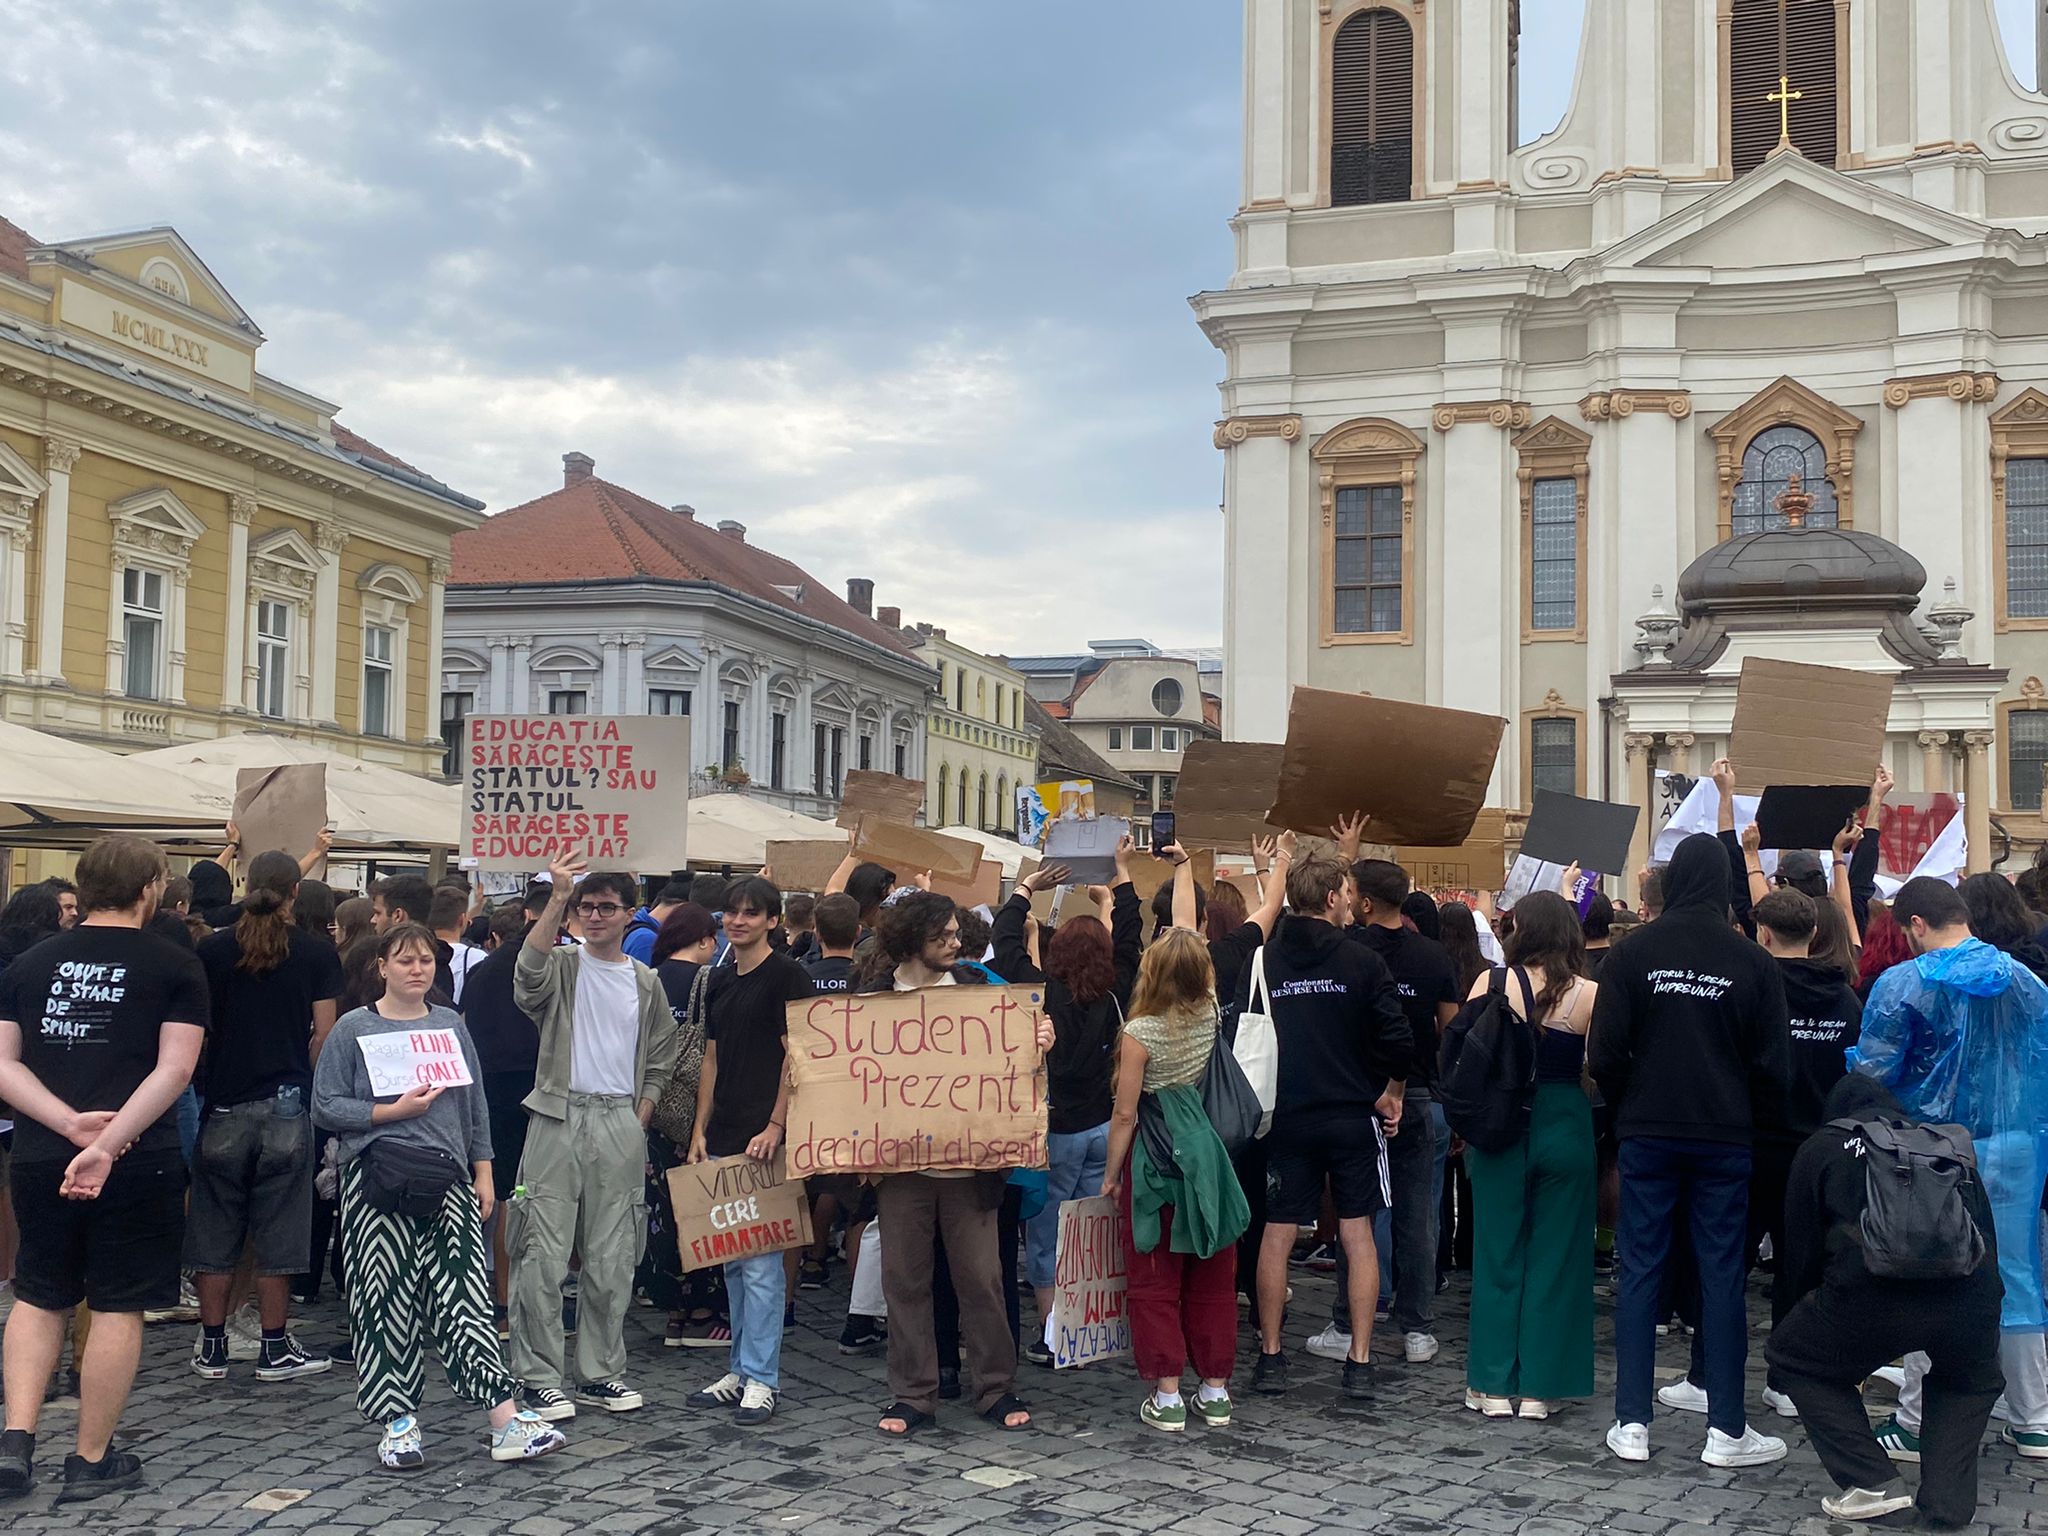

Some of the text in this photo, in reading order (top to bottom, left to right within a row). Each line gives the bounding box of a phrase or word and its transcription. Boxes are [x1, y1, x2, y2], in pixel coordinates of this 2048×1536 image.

[112, 310, 208, 367] MCMLXXX
[471, 743, 634, 774] SĂRĂCEȘTE
[471, 766, 656, 790] STATUL? SAU
[470, 791, 584, 813] STATUL
[471, 813, 629, 841] SĂRĂCEȘTE
[51, 980, 125, 1002] O STARE
[1271, 984, 1347, 998] RESURSE UMANE
[45, 998, 71, 1015] DE
[40, 1017, 90, 1037] SPIRIT
[410, 1033, 456, 1054] PLINE
[372, 1060, 464, 1089] Burse GOALE
[709, 1196, 760, 1230] CERE
